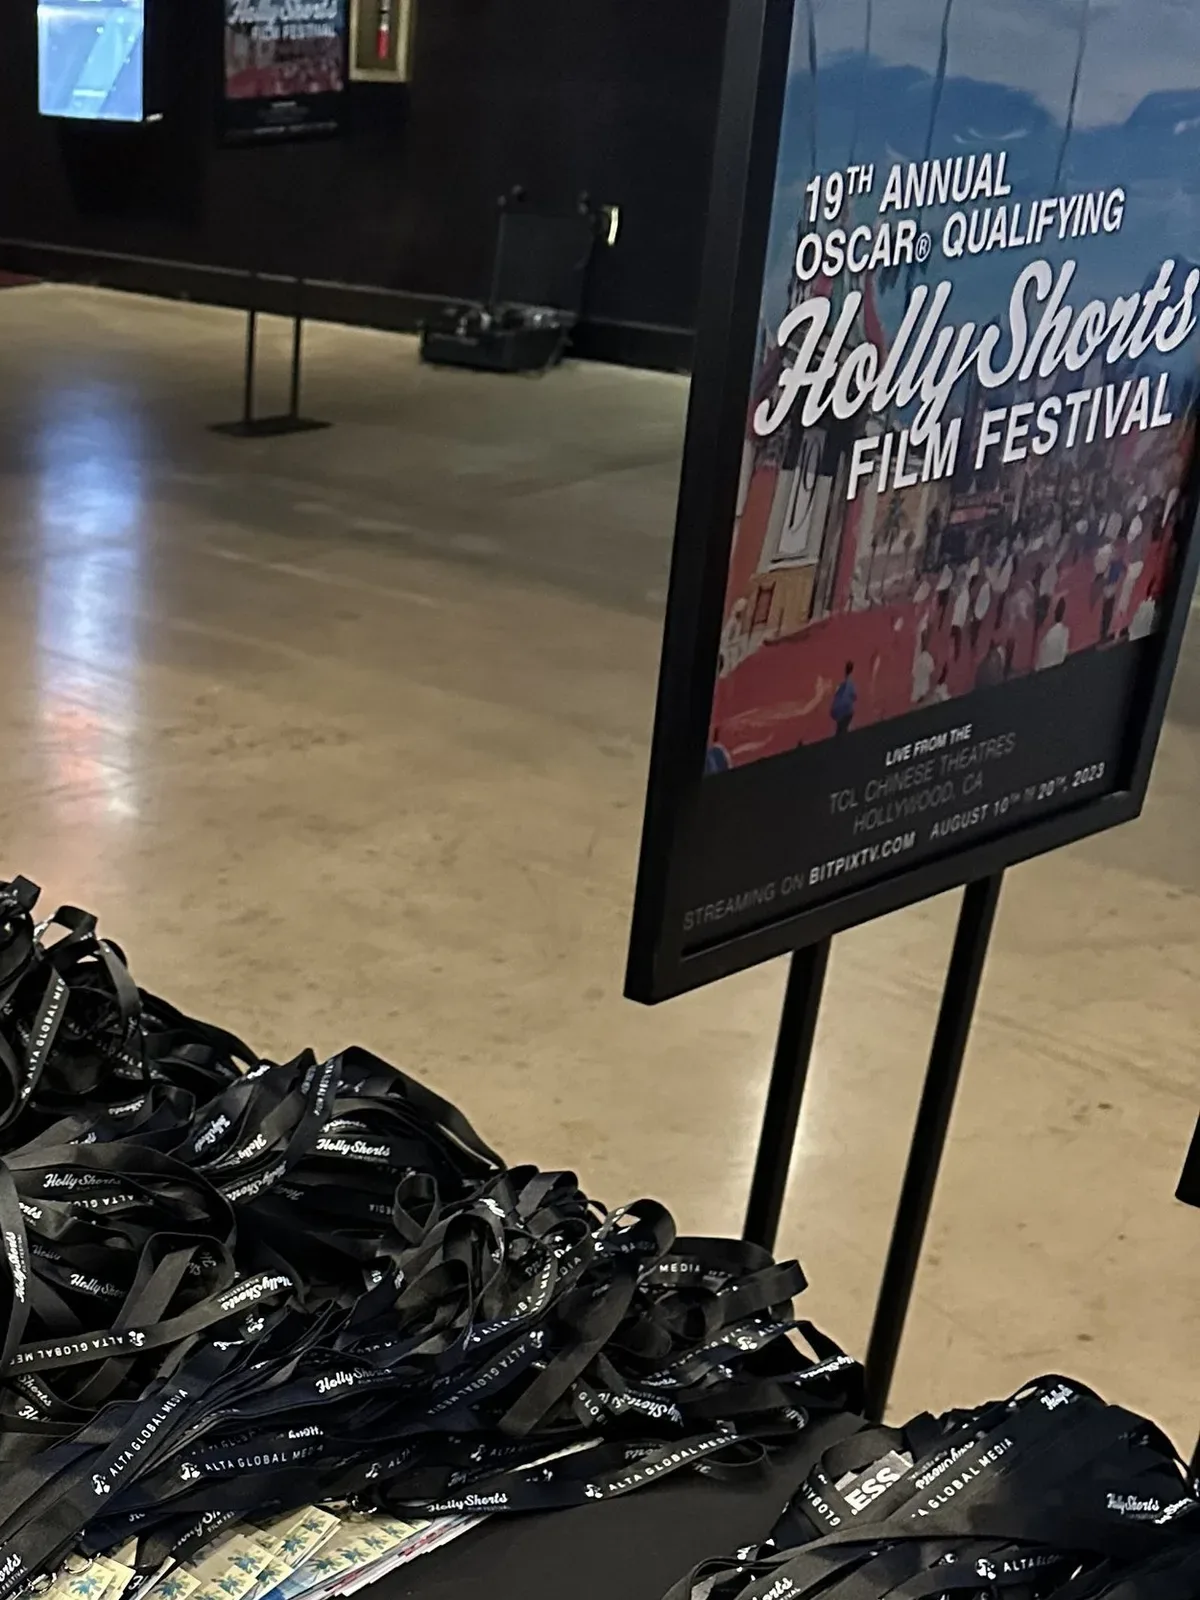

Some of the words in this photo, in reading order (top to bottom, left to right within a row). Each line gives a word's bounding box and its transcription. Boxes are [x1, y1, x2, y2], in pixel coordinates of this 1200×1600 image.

[879, 151, 1012, 213] ANNUAL
[796, 219, 931, 282] OSCAR®
[943, 187, 1126, 258] QUALIFYING
[752, 259, 1200, 447] HollyShorts
[847, 417, 961, 500] FILM
[975, 372, 1173, 469] FESTIVAL
[886, 739, 912, 766] LIVE
[913, 731, 947, 759] FROM
[949, 724, 972, 748] THE
[829, 785, 859, 814] TCL
[865, 763, 934, 802] CHINESE
[940, 732, 1016, 773] THEATRES
[854, 783, 957, 835] HOLLYWOOD,
[962, 773, 984, 796] CA
[683, 882, 777, 931] STREAMING
[781, 871, 805, 896] ON
[809, 831, 916, 885] BITPIXTV.COM
[930, 804, 988, 841] AUGUST
[1073, 762, 1106, 789] 2023
[26, 1050, 41, 1079] ALTA
[35, 1003, 59, 1047] GLOBAL
[316, 1138, 391, 1157] HollyShorts
[43, 1173, 122, 1188] HollyShorts
[659, 1263, 701, 1274] MEDIA
[36, 1341, 89, 1358] GLOBAL
[91, 1335, 124, 1349] ALTA
[499, 1344, 527, 1369] ALTA
[315, 1367, 393, 1394] HollyShorts
[456, 1366, 501, 1397] GLOBAL
[108, 1450, 134, 1478] ALTA
[131, 1408, 167, 1452] GLOBAL
[161, 1387, 189, 1413] MEDIA
[204, 1459, 235, 1472] ALTA
[238, 1451, 287, 1468] GLOBAL
[608, 1473, 643, 1492] ALTA
[645, 1446, 699, 1476] GLOBAL
[699, 1433, 739, 1452] MEDIA
[927, 1466, 980, 1509] GLOBAL
[978, 1438, 1014, 1468] MEDIA
[426, 1492, 508, 1513] HollyShorts
[845, 1465, 902, 1514] ESS
[1, 1566, 29, 1591] FESTIVAL
[1003, 1557, 1034, 1573] ALTA
